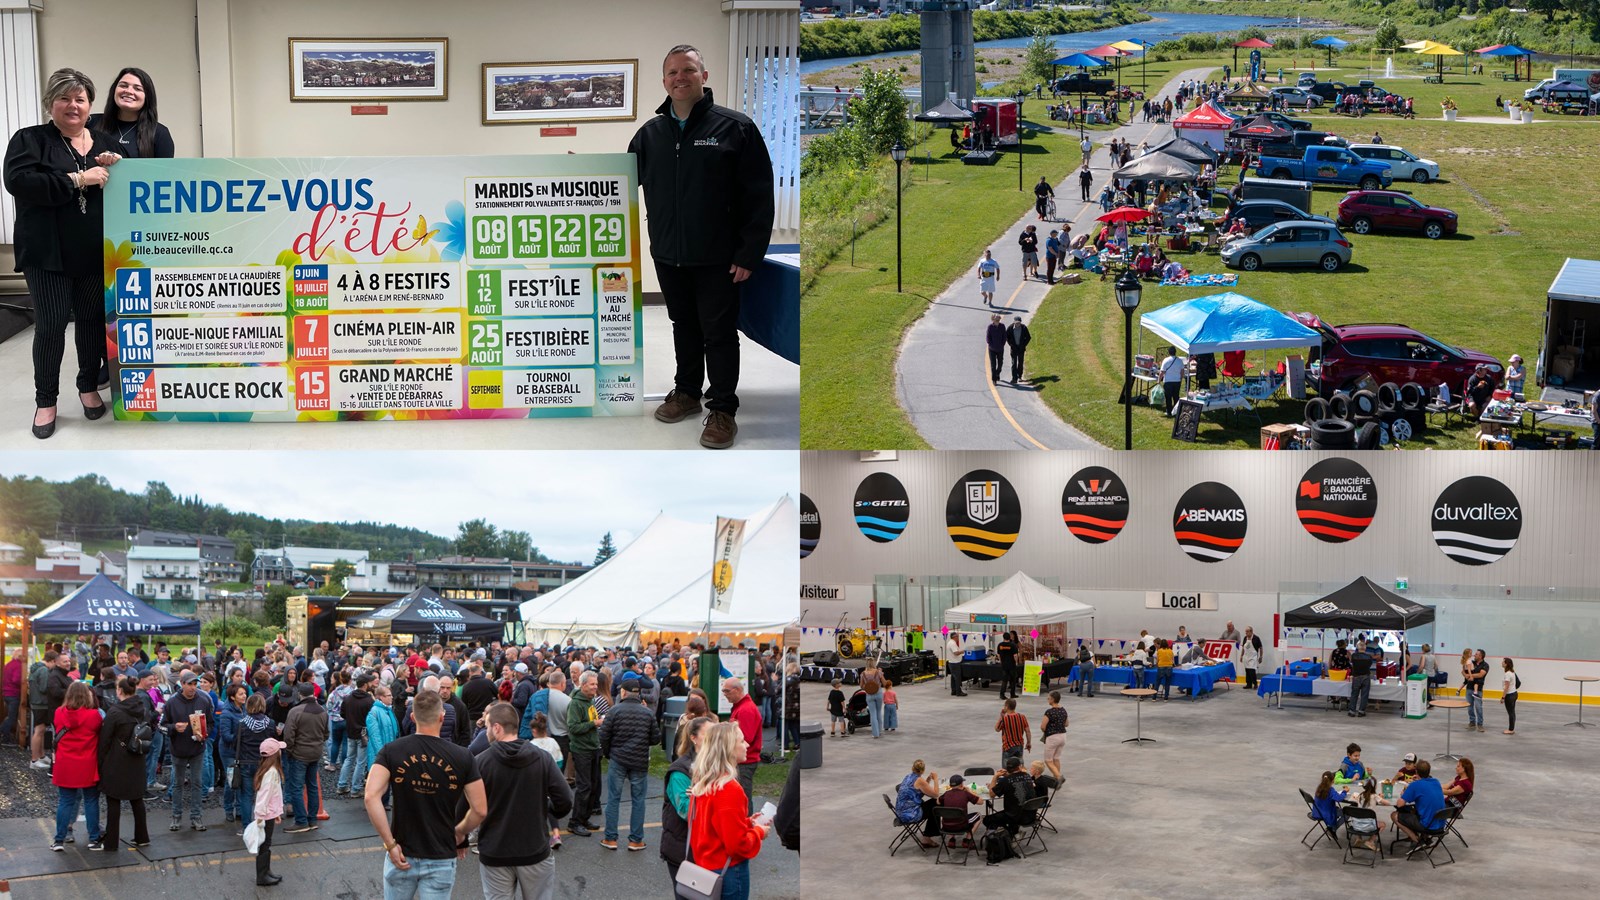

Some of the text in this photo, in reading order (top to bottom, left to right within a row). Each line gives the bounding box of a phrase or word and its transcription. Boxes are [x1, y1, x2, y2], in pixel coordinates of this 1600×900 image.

[474, 180, 619, 199] MARDIS EN MUSIQUE
[129, 178, 374, 214] RENDEZ-VOUS
[475, 201, 524, 209] STATIONNEMENT
[525, 200, 565, 208] POLYVALENTE
[566, 199, 604, 208] ST-FRANÇOIS
[605, 198, 609, 207] /
[292, 201, 421, 261] d'été
[476, 217, 622, 243] 08 15 22 29
[145, 232, 210, 242] SUIVEZ-NOUS
[131, 245, 233, 256] ville.beauceville.qc.ca
[479, 242, 620, 255] AOÛT AOÛT AOÛT AOÛT
[154, 271, 281, 282] RASSEMBLEMENT DE LA CHAUDIÈRE
[295, 269, 320, 279] 9 JUIN
[125, 272, 141, 296] 4
[336, 270, 450, 290] 4 À 8 FESTIFS
[478, 273, 490, 287] 11
[155, 282, 281, 298] AUTOS ANTIQUES
[295, 283, 328, 293] 14 JUILLET
[508, 276, 580, 297] FEST'ÎLE
[343, 293, 444, 302] À L'ARÉNA EJM RENÉ-BERNARD
[478, 288, 492, 302] 12
[604, 295, 626, 304] VIENS
[119, 298, 149, 313] JUIN
[154, 300, 216, 310] SUR L'ÎLE RONDE
[295, 296, 328, 307] 18 AOÛT
[514, 299, 575, 308] SUR L'ÎLE RONDE
[474, 302, 496, 314] AOÛT
[610, 304, 620, 312] AU
[600, 312, 631, 322] MARCHÉ
[155, 326, 283, 340] PIQUE-NIQUE FAMILIAL
[305, 319, 318, 343] 7
[334, 320, 455, 336] CINÉMA PLEIN-AIR
[122, 322, 148, 346] 16
[472, 324, 500, 348] 25
[506, 328, 589, 347] FESTIBIÈRE
[156, 342, 194, 350] APRÈS-MIDI
[196, 342, 203, 350] ET
[204, 341, 228, 350] SOIRÉE
[244, 340, 259, 349] L'ÎLE
[383, 337, 396, 346] L'ÎLE
[399, 338, 422, 346] RONDE
[122, 348, 151, 362] JUIN
[297, 347, 328, 358] JUILLET
[471, 348, 501, 363] AOÛT
[516, 349, 531, 358] SUR
[532, 348, 549, 357] L'ÎLE
[131, 372, 145, 383] 29
[339, 365, 453, 383] GRAND MARCHÉ
[526, 372, 571, 382] TOURNOI
[126, 384, 143, 394] JUIN
[300, 372, 324, 395] 15
[384, 383, 398, 391] L'ÎLE
[516, 384, 580, 394] DE BASEBALL
[161, 382, 283, 399] BEAUCE ROCK
[357, 392, 383, 400] VENTE
[386, 392, 396, 400] DE
[399, 390, 442, 400] DÉBARRAS
[470, 385, 501, 394] SEPTEMBRE
[126, 400, 155, 410] JUILLET
[298, 399, 328, 409] JUILLET
[340, 401, 356, 409] 15-16
[524, 396, 573, 404] ENTREPRISES
[1323, 476, 1371, 485] FINANCIÈRE
[974, 489, 978, 498] E
[1323, 493, 1367, 501] NATIONALE
[974, 504, 992, 513] J M
[1434, 503, 1518, 520] duvaltex
[105, 600, 135, 609] BOIS
[1162, 592, 1200, 608] Local
[88, 607, 139, 617] LOCAL
[417, 609, 464, 619] SHAKER
[77, 621, 162, 632] JE BOIS LOCAL
[445, 623, 466, 632] SHAKER
[1204, 643, 1232, 659] IGA
[394, 754, 458, 790] QUIKSILVER
